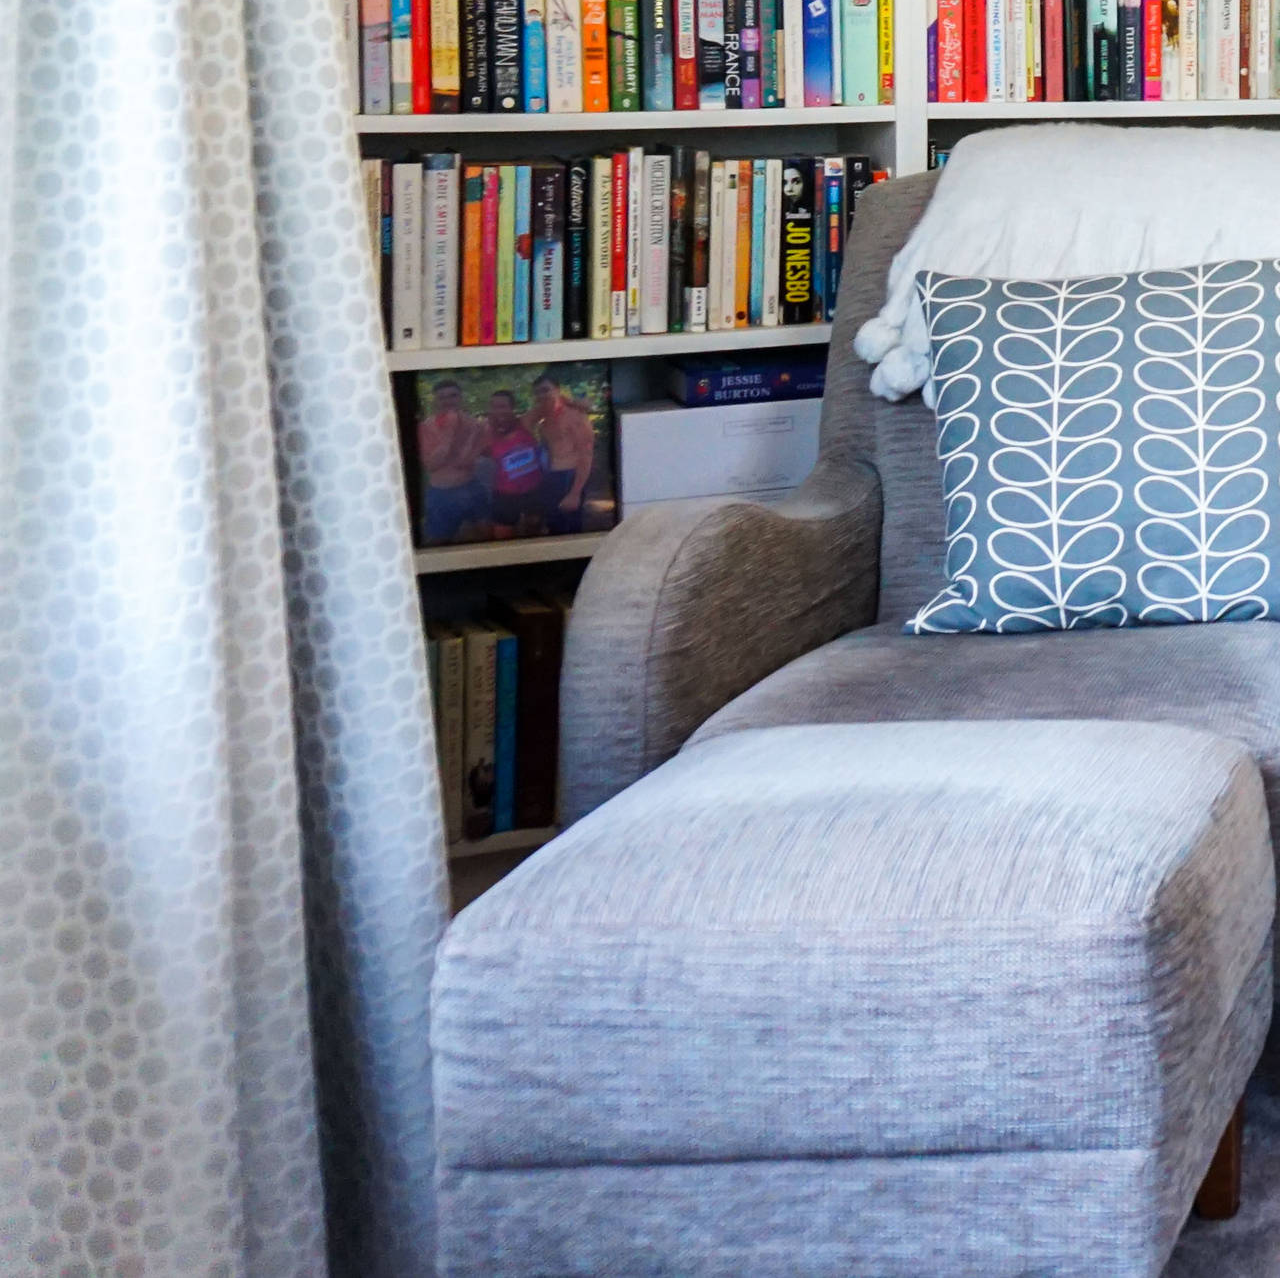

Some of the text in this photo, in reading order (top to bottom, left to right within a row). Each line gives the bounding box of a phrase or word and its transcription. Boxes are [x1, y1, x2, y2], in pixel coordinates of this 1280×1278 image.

[476, 19, 487, 34] ON
[1220, 0, 1235, 31] keyes
[465, 26, 476, 79] HAWKINS
[477, 38, 488, 58] THE
[623, 5, 638, 94] LIANE MORIARTY
[725, 33, 741, 97] FRANCE
[1124, 26, 1138, 85] rumours
[477, 61, 488, 94] TRAIN
[600, 189, 611, 226] SILVER
[599, 229, 611, 269] SWORD
[784, 222, 812, 304] JO NESBO
[713, 386, 772, 402] BURTON
[720, 374, 764, 389] JESSIE
